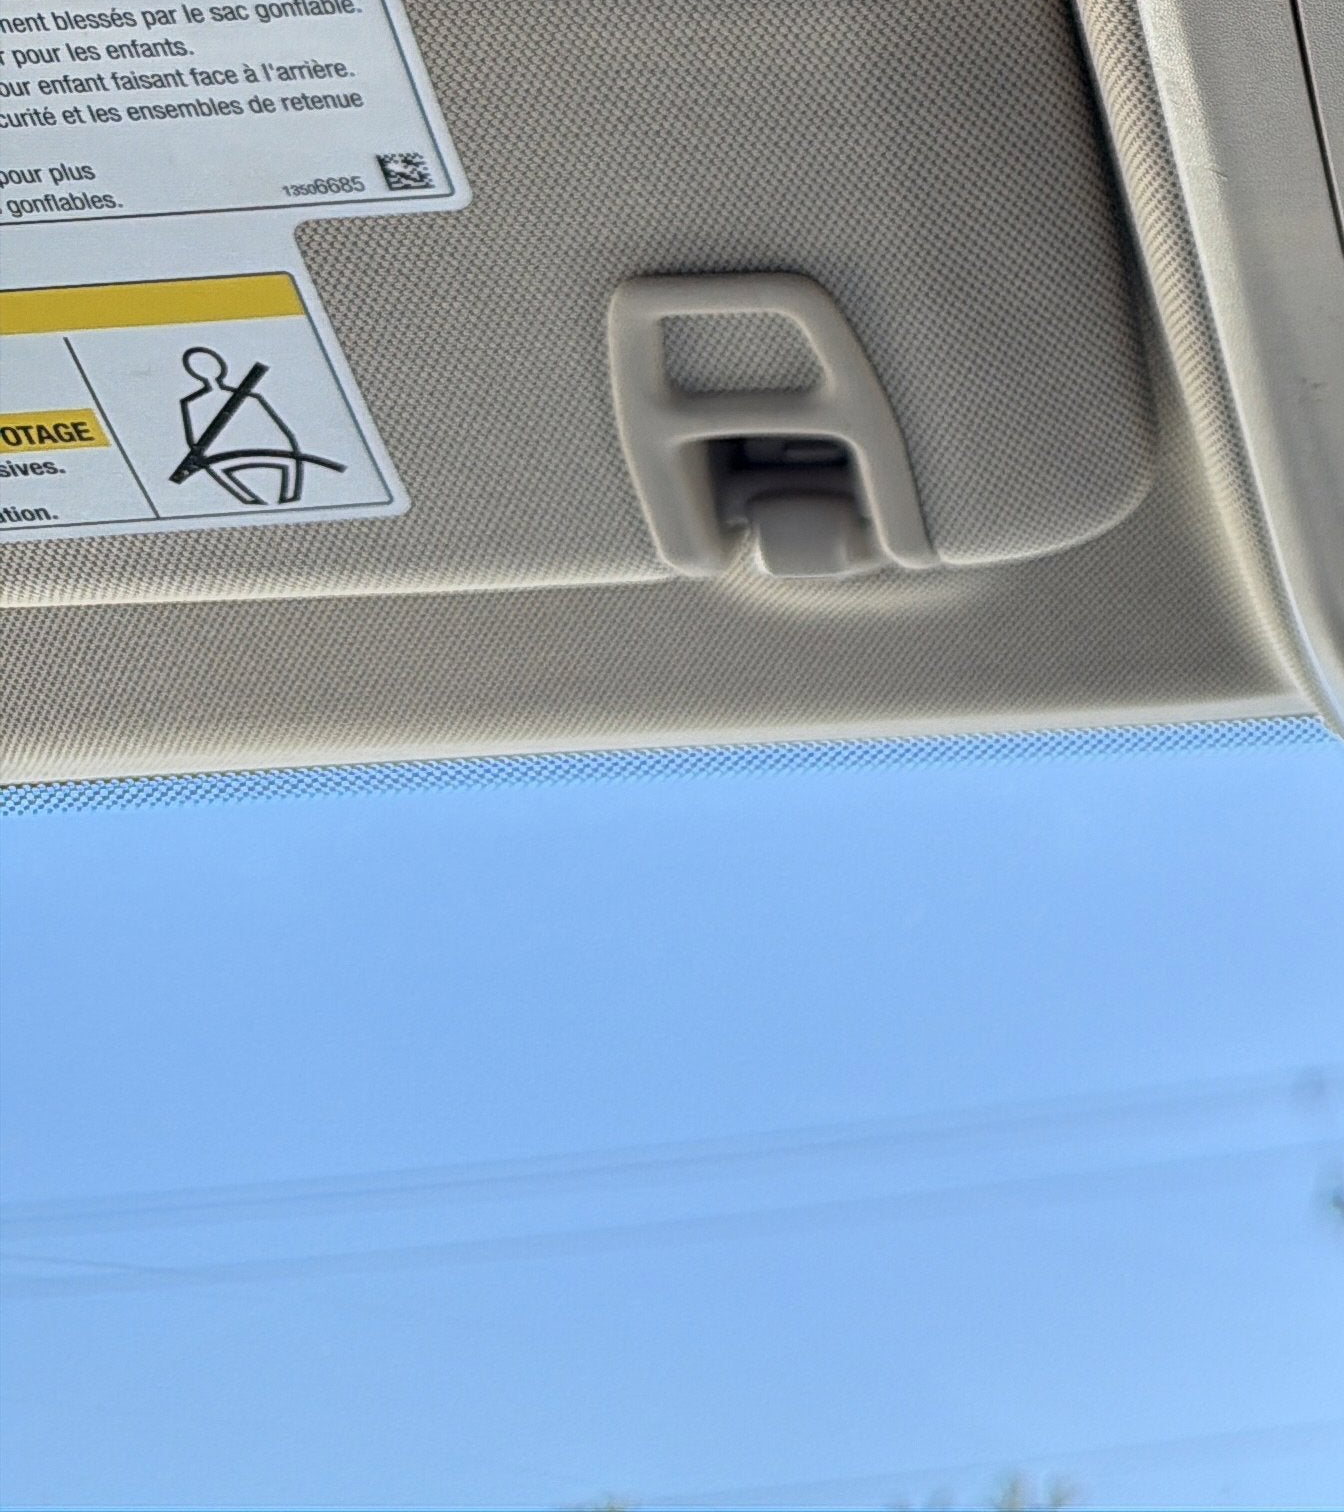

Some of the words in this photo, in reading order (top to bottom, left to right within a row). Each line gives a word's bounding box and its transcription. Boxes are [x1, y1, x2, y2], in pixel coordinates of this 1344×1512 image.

[51, 8, 138, 31] blessés
[141, 8, 177, 29] par
[181, 4, 205, 23] le
[209, 4, 249, 22] sac
[12, 47, 61, 68] pour
[65, 43, 101, 62] les
[106, 39, 194, 60] enfants.
[38, 74, 110, 95] enfant
[111, 70, 189, 91] faisant
[190, 68, 239, 86] face
[243, 63, 260, 83] à
[261, 59, 355, 82] l'arrière.
[62, 106, 87, 124] et
[87, 105, 122, 123] les
[126, 98, 244, 121] ensembles
[248, 95, 277, 114] de
[281, 92, 364, 112] retenue
[49, 163, 96, 186] plus
[282, 176, 365, 197] 13506685
[6, 192, 124, 218] gonflables.
[0, 421, 95, 447] OTAGE
